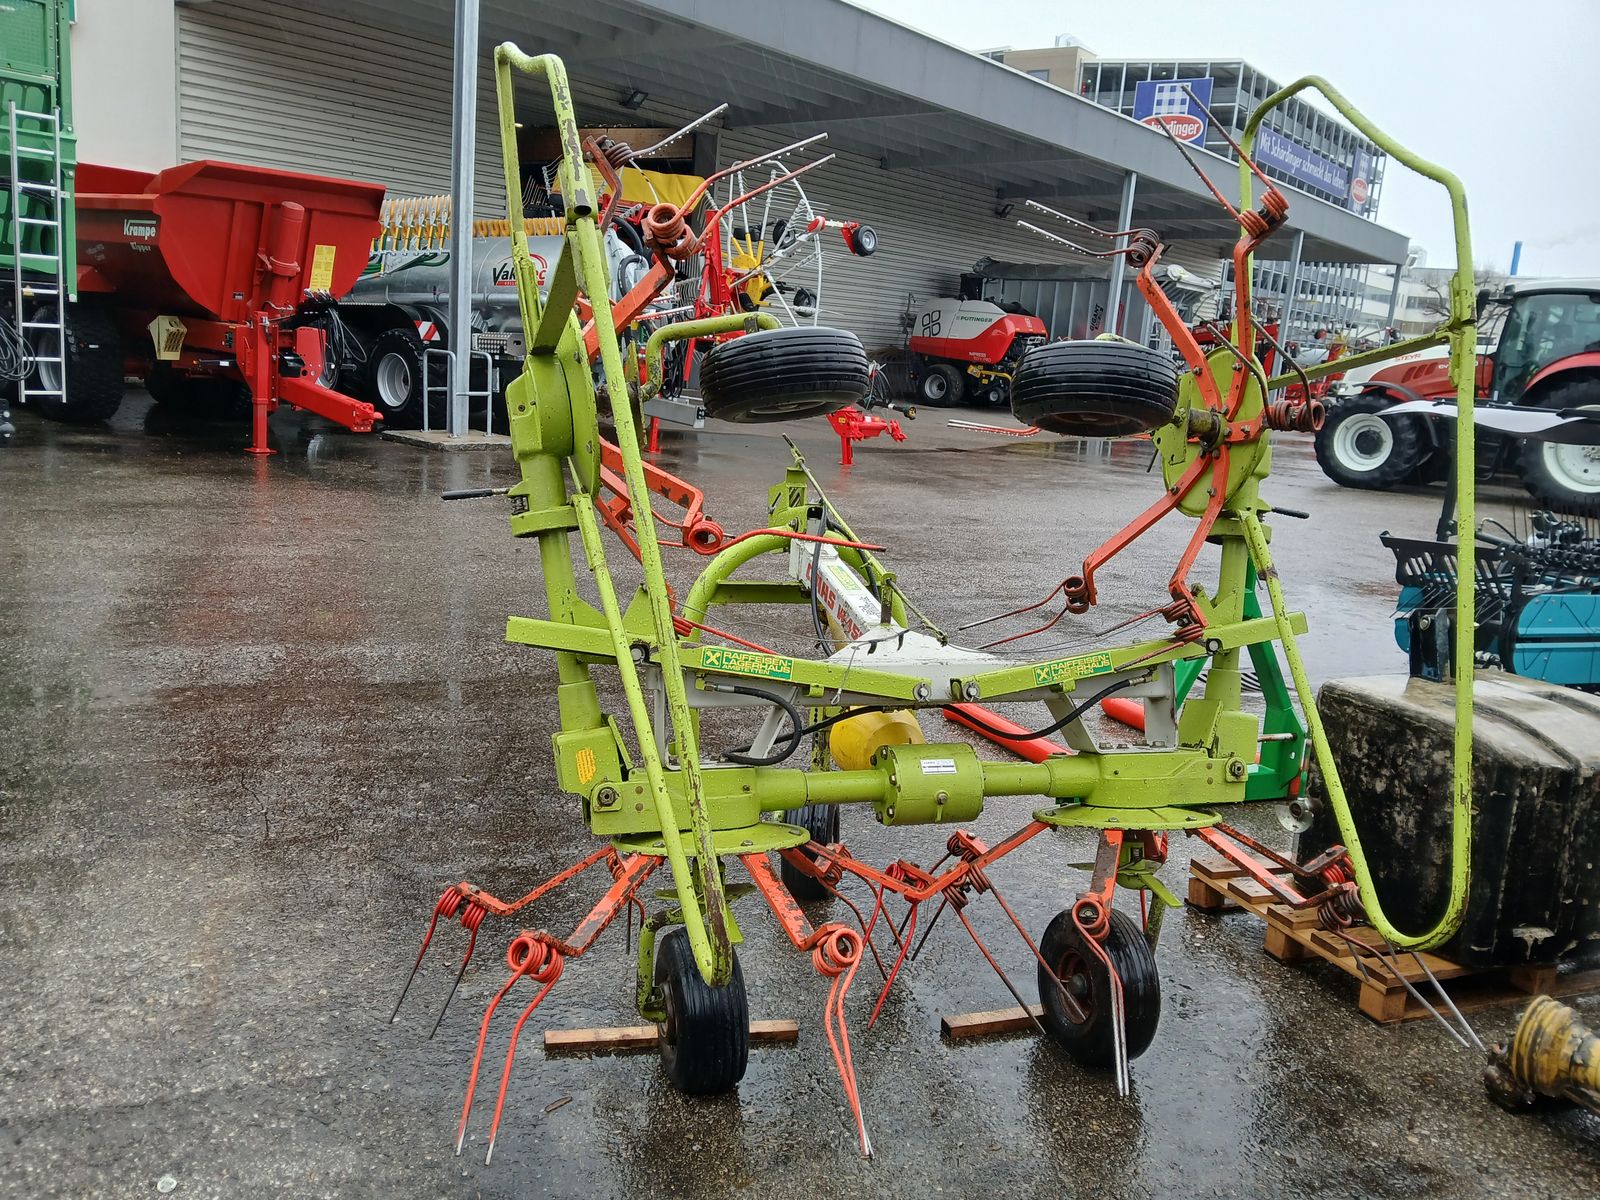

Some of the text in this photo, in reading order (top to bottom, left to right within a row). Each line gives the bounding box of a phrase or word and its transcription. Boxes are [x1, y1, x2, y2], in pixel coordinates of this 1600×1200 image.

[1260, 131, 1271, 154] Mit
[123, 218, 156, 240] Krampe
[492, 263, 546, 286] Vakc
[805, 562, 836, 610] CAAS
[723, 651, 791, 667] RAIFFEISEN-
[723, 657, 791, 674] LAGERHAUS
[1050, 654, 1109, 671] RAIFFEISEN-
[1051, 659, 1110, 675] LAGERHAUS
[721, 664, 770, 675] AMSTETTEN
